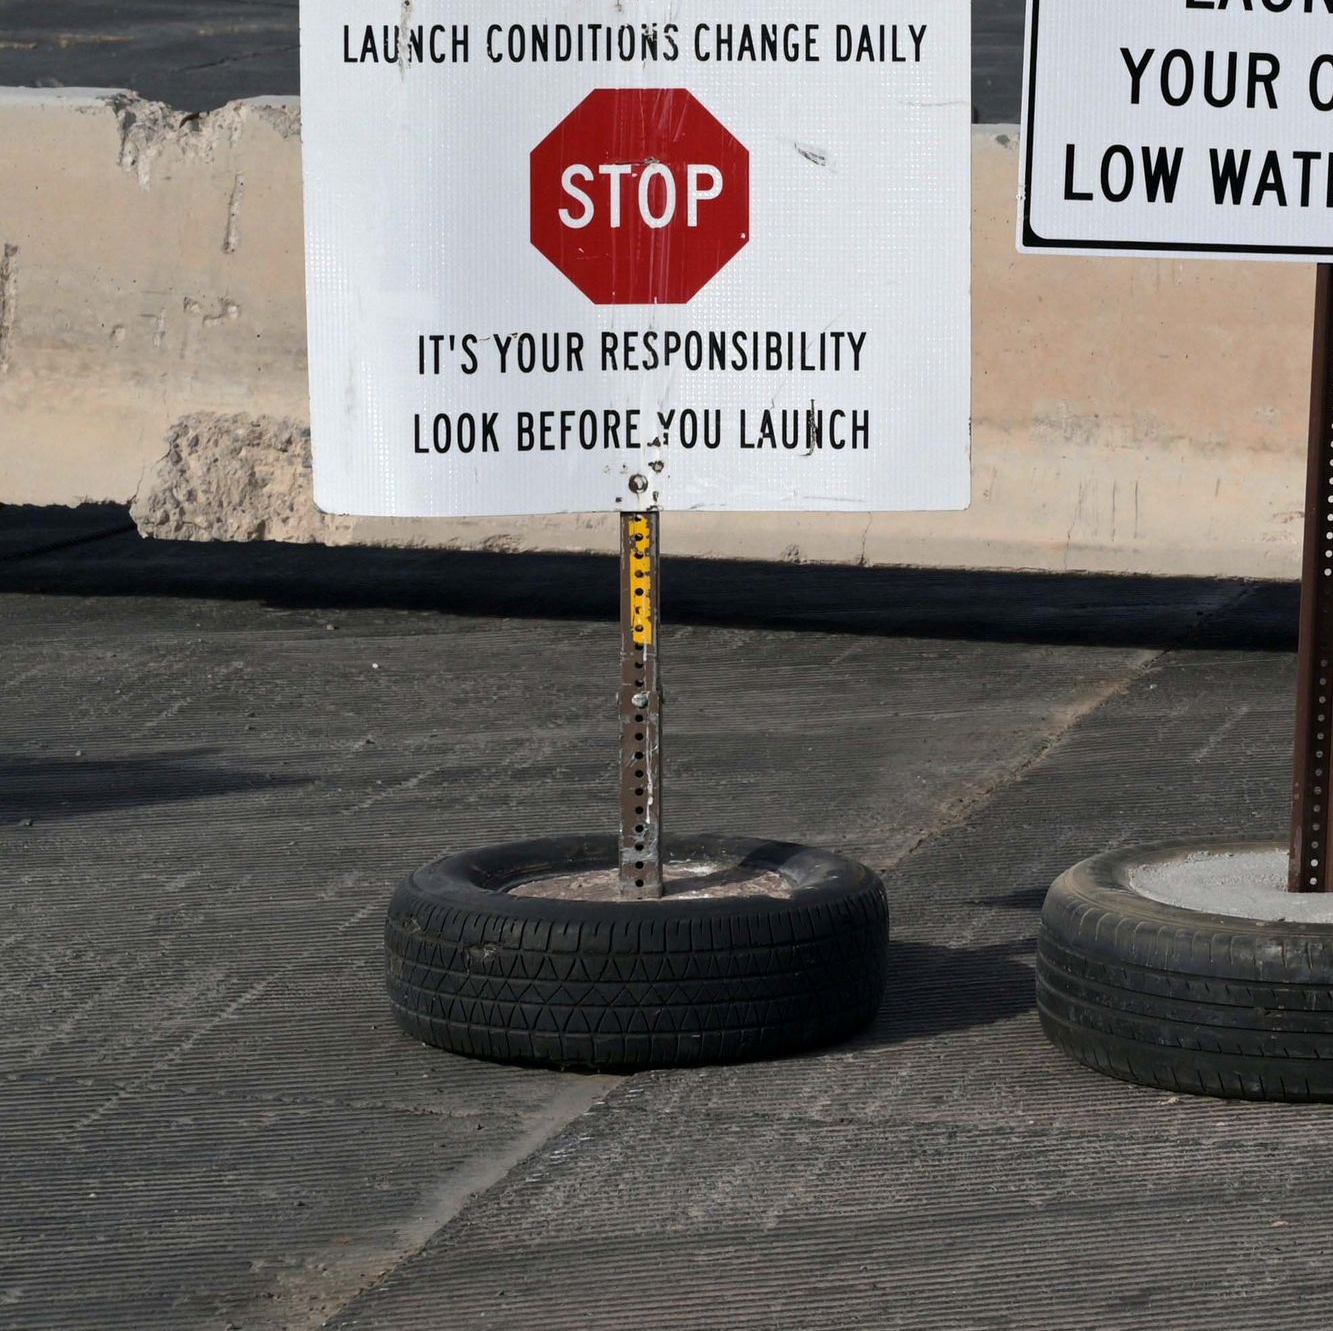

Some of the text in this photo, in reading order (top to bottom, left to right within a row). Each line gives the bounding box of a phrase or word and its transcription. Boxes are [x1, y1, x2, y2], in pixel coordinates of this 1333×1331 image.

[342, 23, 926, 65] LAUNCH CONDITIONS CHANGE DAILY
[1120, 48, 1280, 109] YOUR
[559, 161, 723, 228] STOP
[1064, 144, 1183, 203] LOW
[420, 331, 866, 374] IT'S YOUR RESPONSIBILITY
[415, 409, 869, 453] LOOK BEFORE YOU LAUNCH
